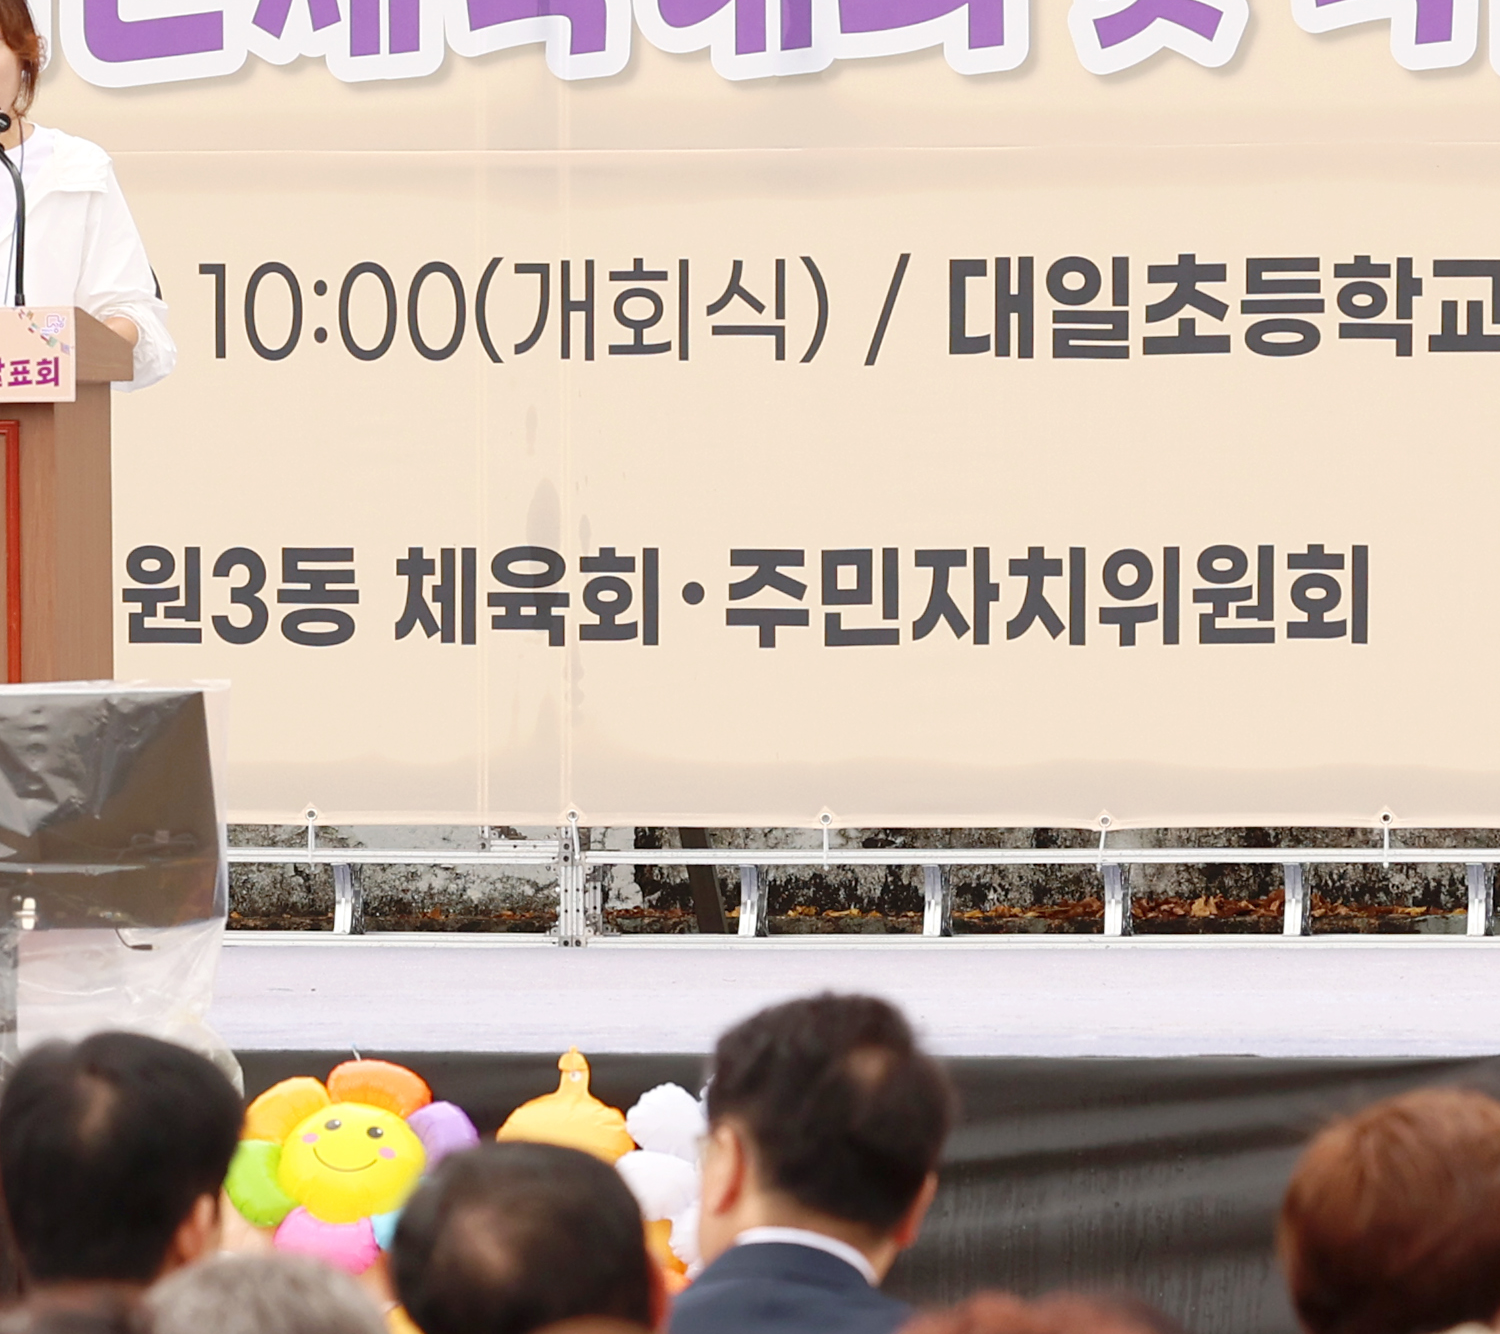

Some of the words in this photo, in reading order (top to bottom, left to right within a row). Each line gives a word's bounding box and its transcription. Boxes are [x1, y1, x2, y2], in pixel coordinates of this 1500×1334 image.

[198, 256, 830, 364] 10:00(개회식)
[864, 253, 911, 366] /
[394, 543, 1370, 649] 체육회·주민자치위원회
